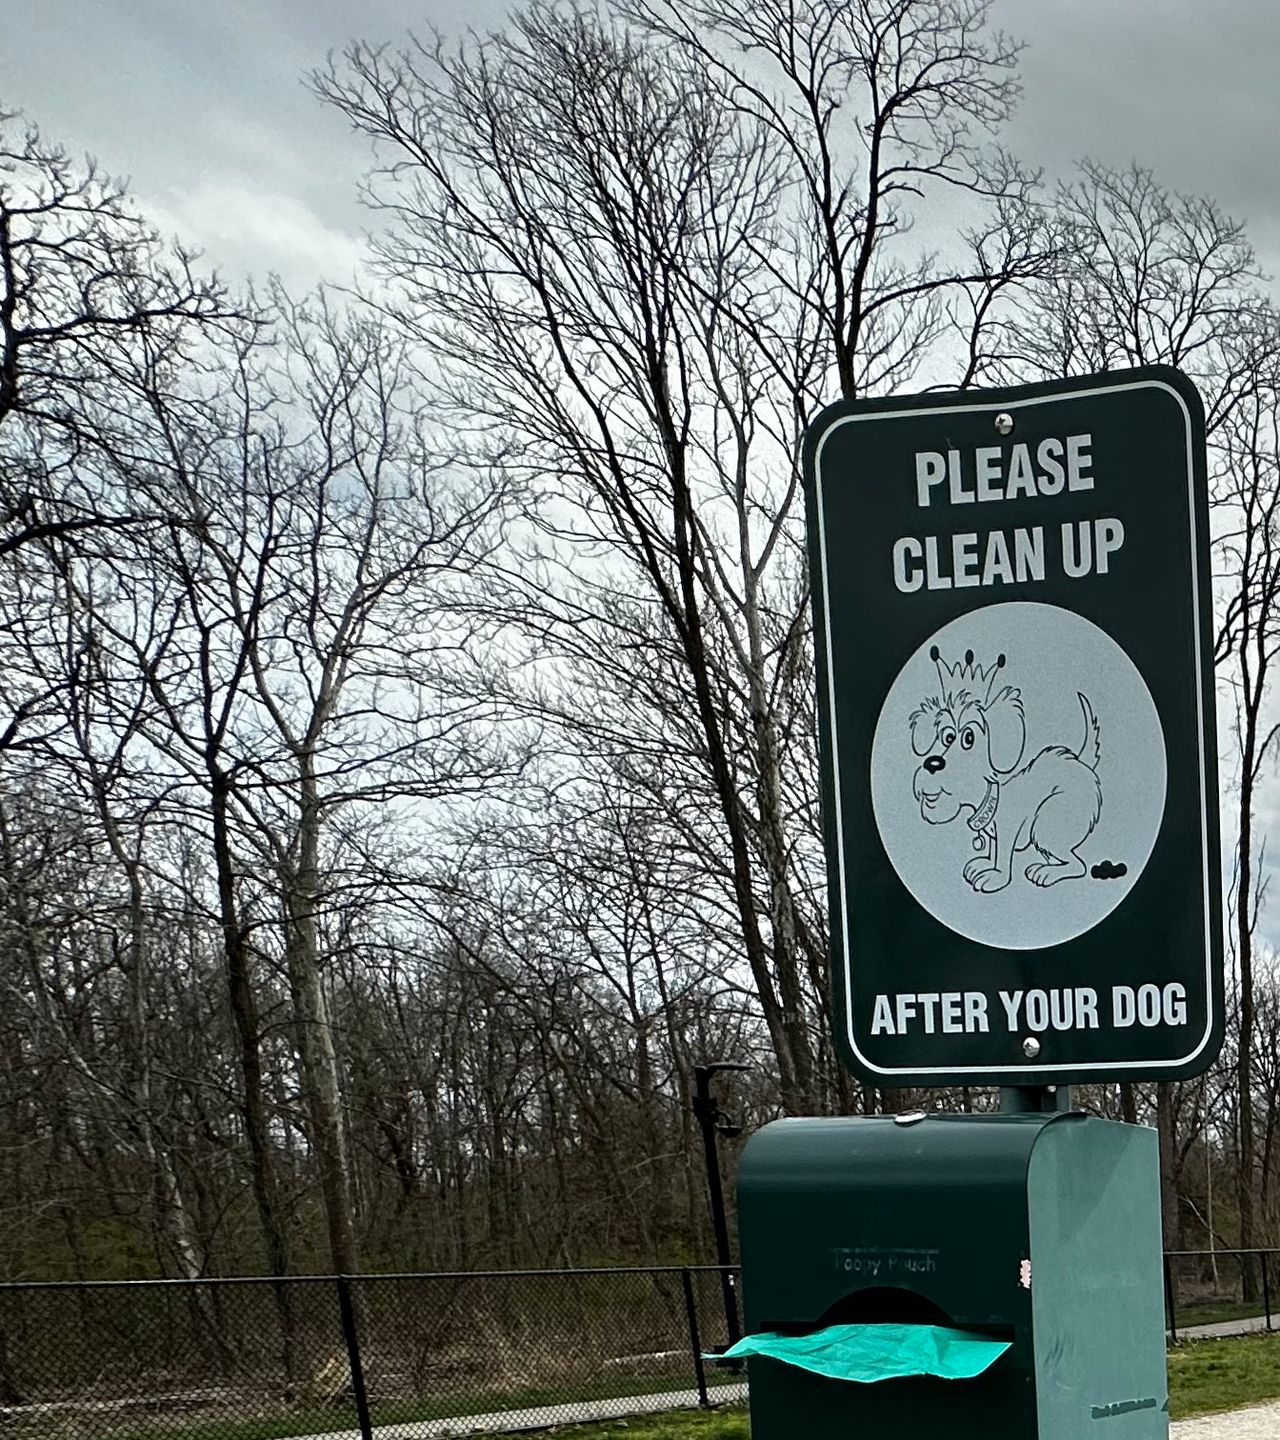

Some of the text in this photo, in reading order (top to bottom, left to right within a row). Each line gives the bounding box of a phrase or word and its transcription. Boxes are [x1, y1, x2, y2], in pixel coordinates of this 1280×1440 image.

[915, 433, 1095, 507] PLEASE
[892, 517, 1126, 593] CLEAN UP
[974, 795, 997, 829] CROWN
[871, 982, 1187, 1035] AFTER YOUR DOG
